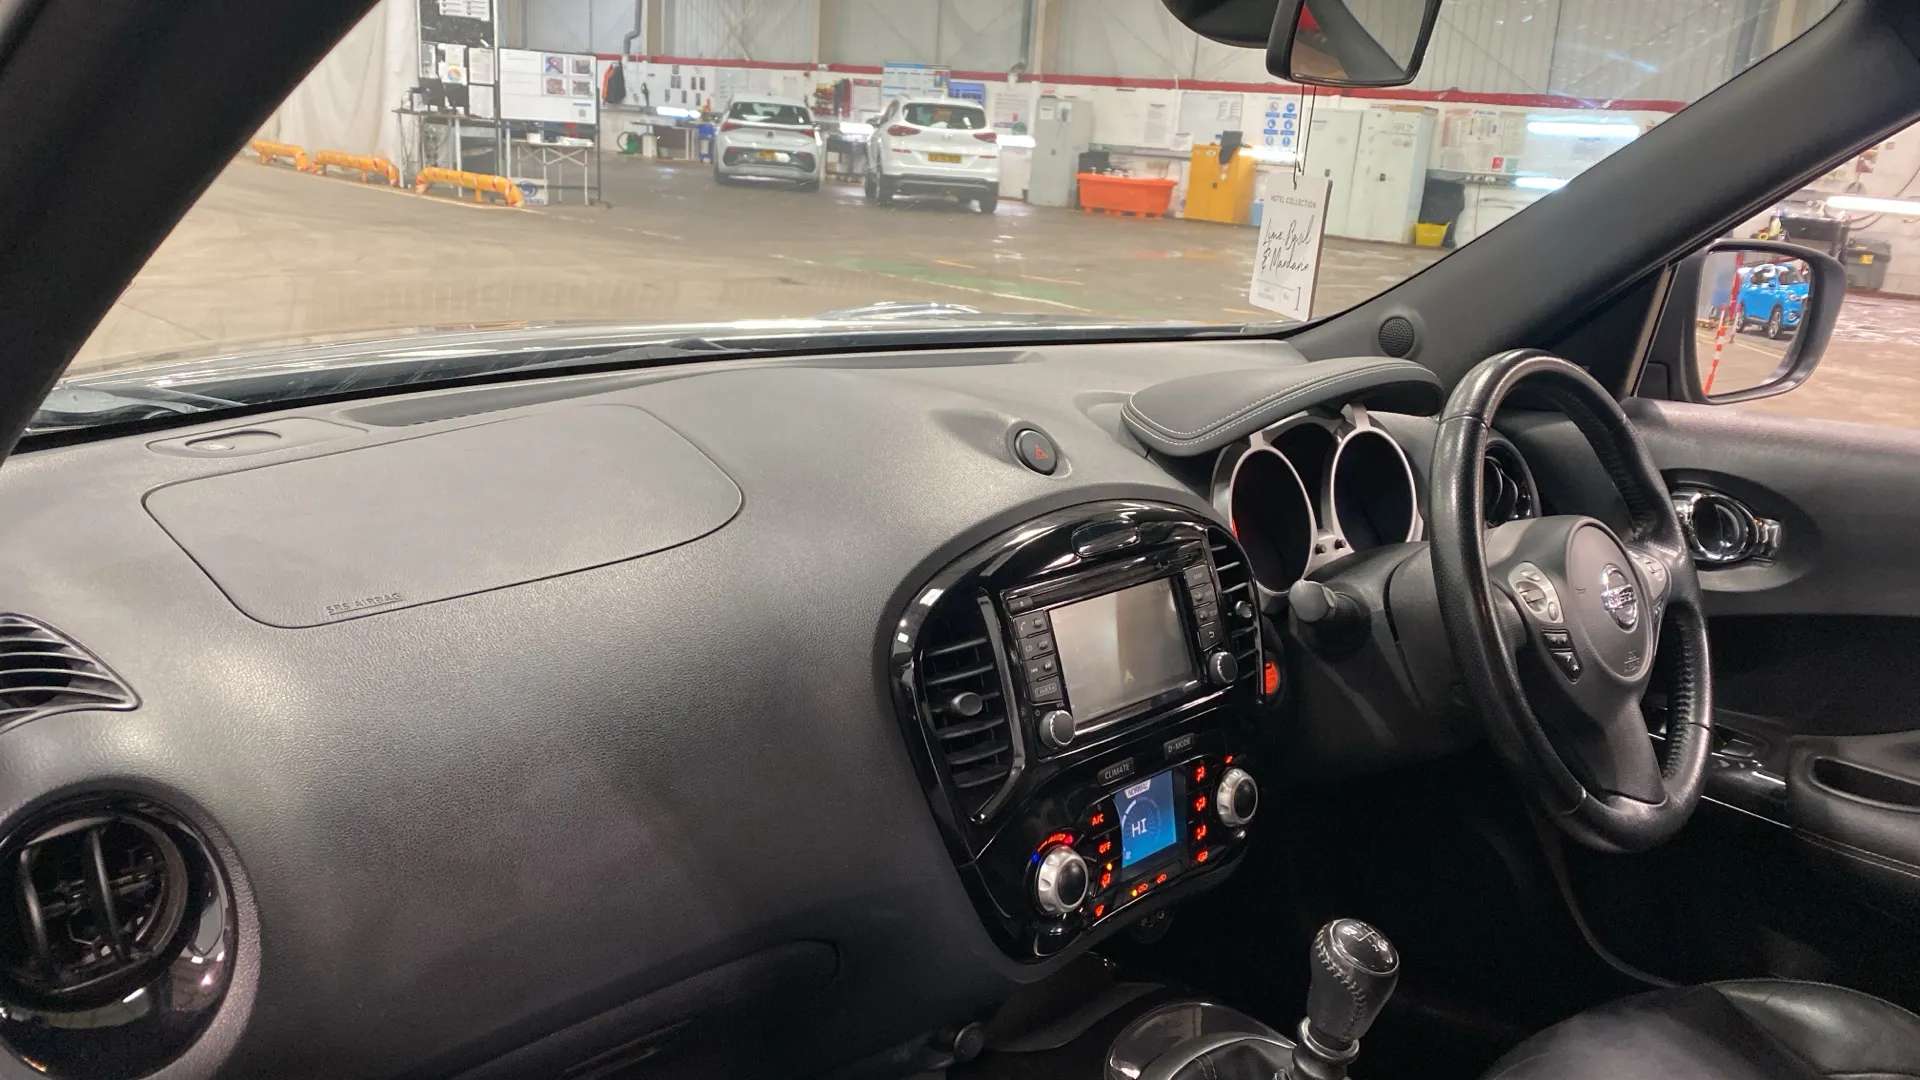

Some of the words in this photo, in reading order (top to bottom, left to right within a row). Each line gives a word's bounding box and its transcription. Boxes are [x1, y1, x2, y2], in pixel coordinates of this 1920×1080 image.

[354, 592, 401, 607] AIRBAG
[1103, 762, 1131, 780] CLIMATE
[1131, 818, 1147, 838] HI
